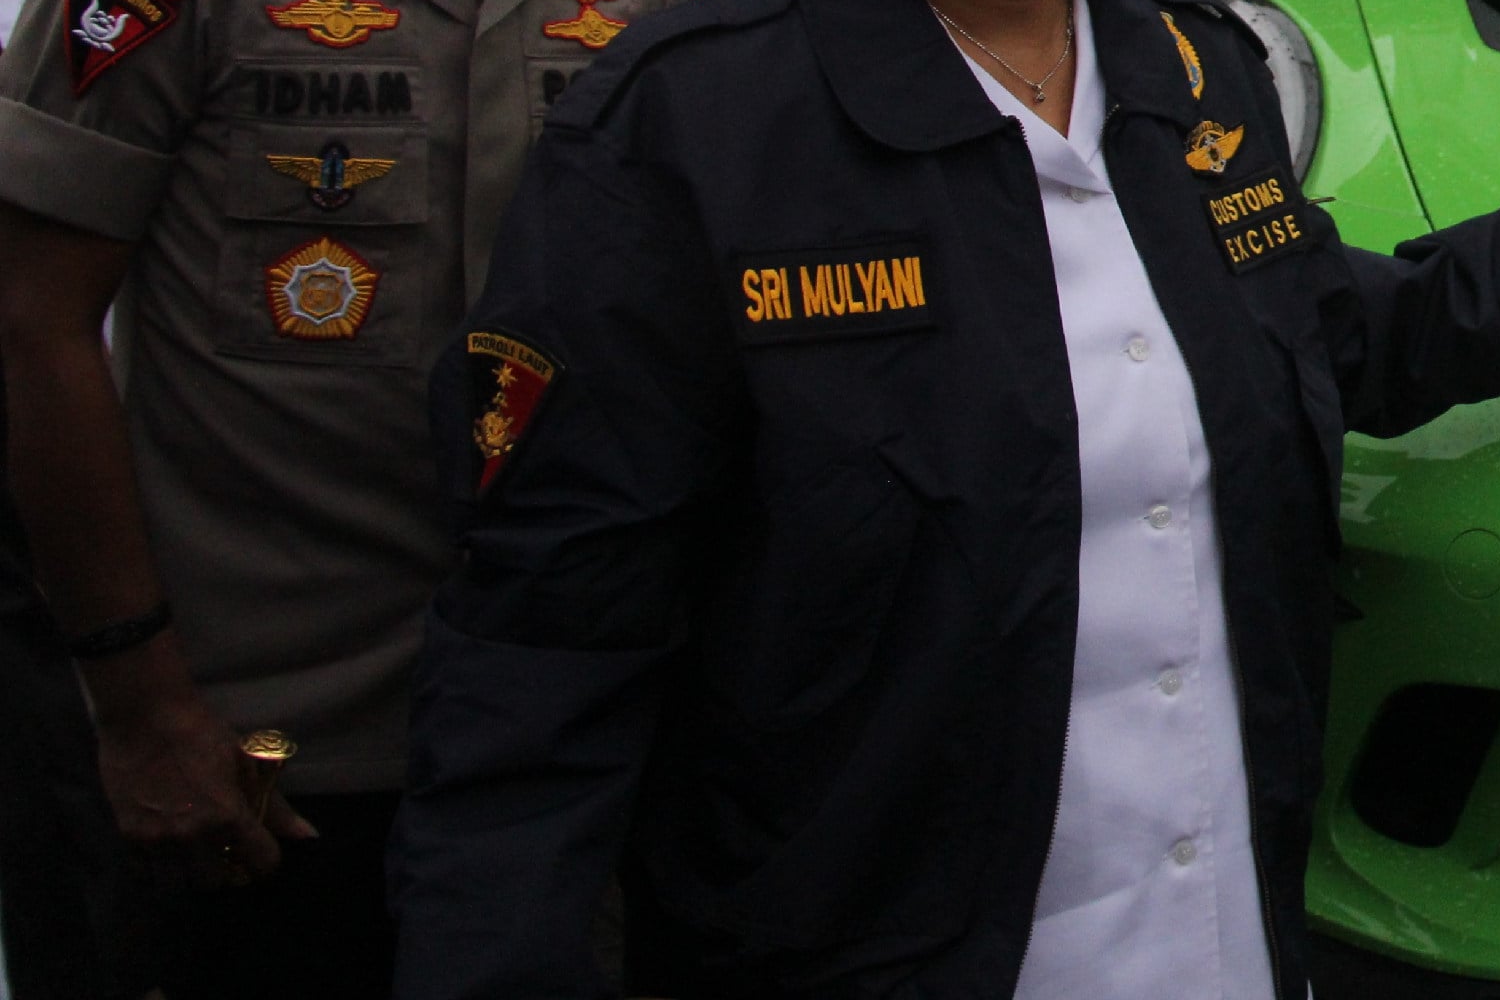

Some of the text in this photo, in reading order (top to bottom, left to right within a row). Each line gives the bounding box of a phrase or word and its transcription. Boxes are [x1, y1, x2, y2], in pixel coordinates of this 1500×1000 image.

[255, 69, 412, 115] IDHAM
[1209, 177, 1286, 226] CUSTOMS
[1225, 214, 1302, 264] EXCISE
[741, 256, 927, 322] SRI MULYANI
[472, 335, 549, 375] PATROLI LAUT
